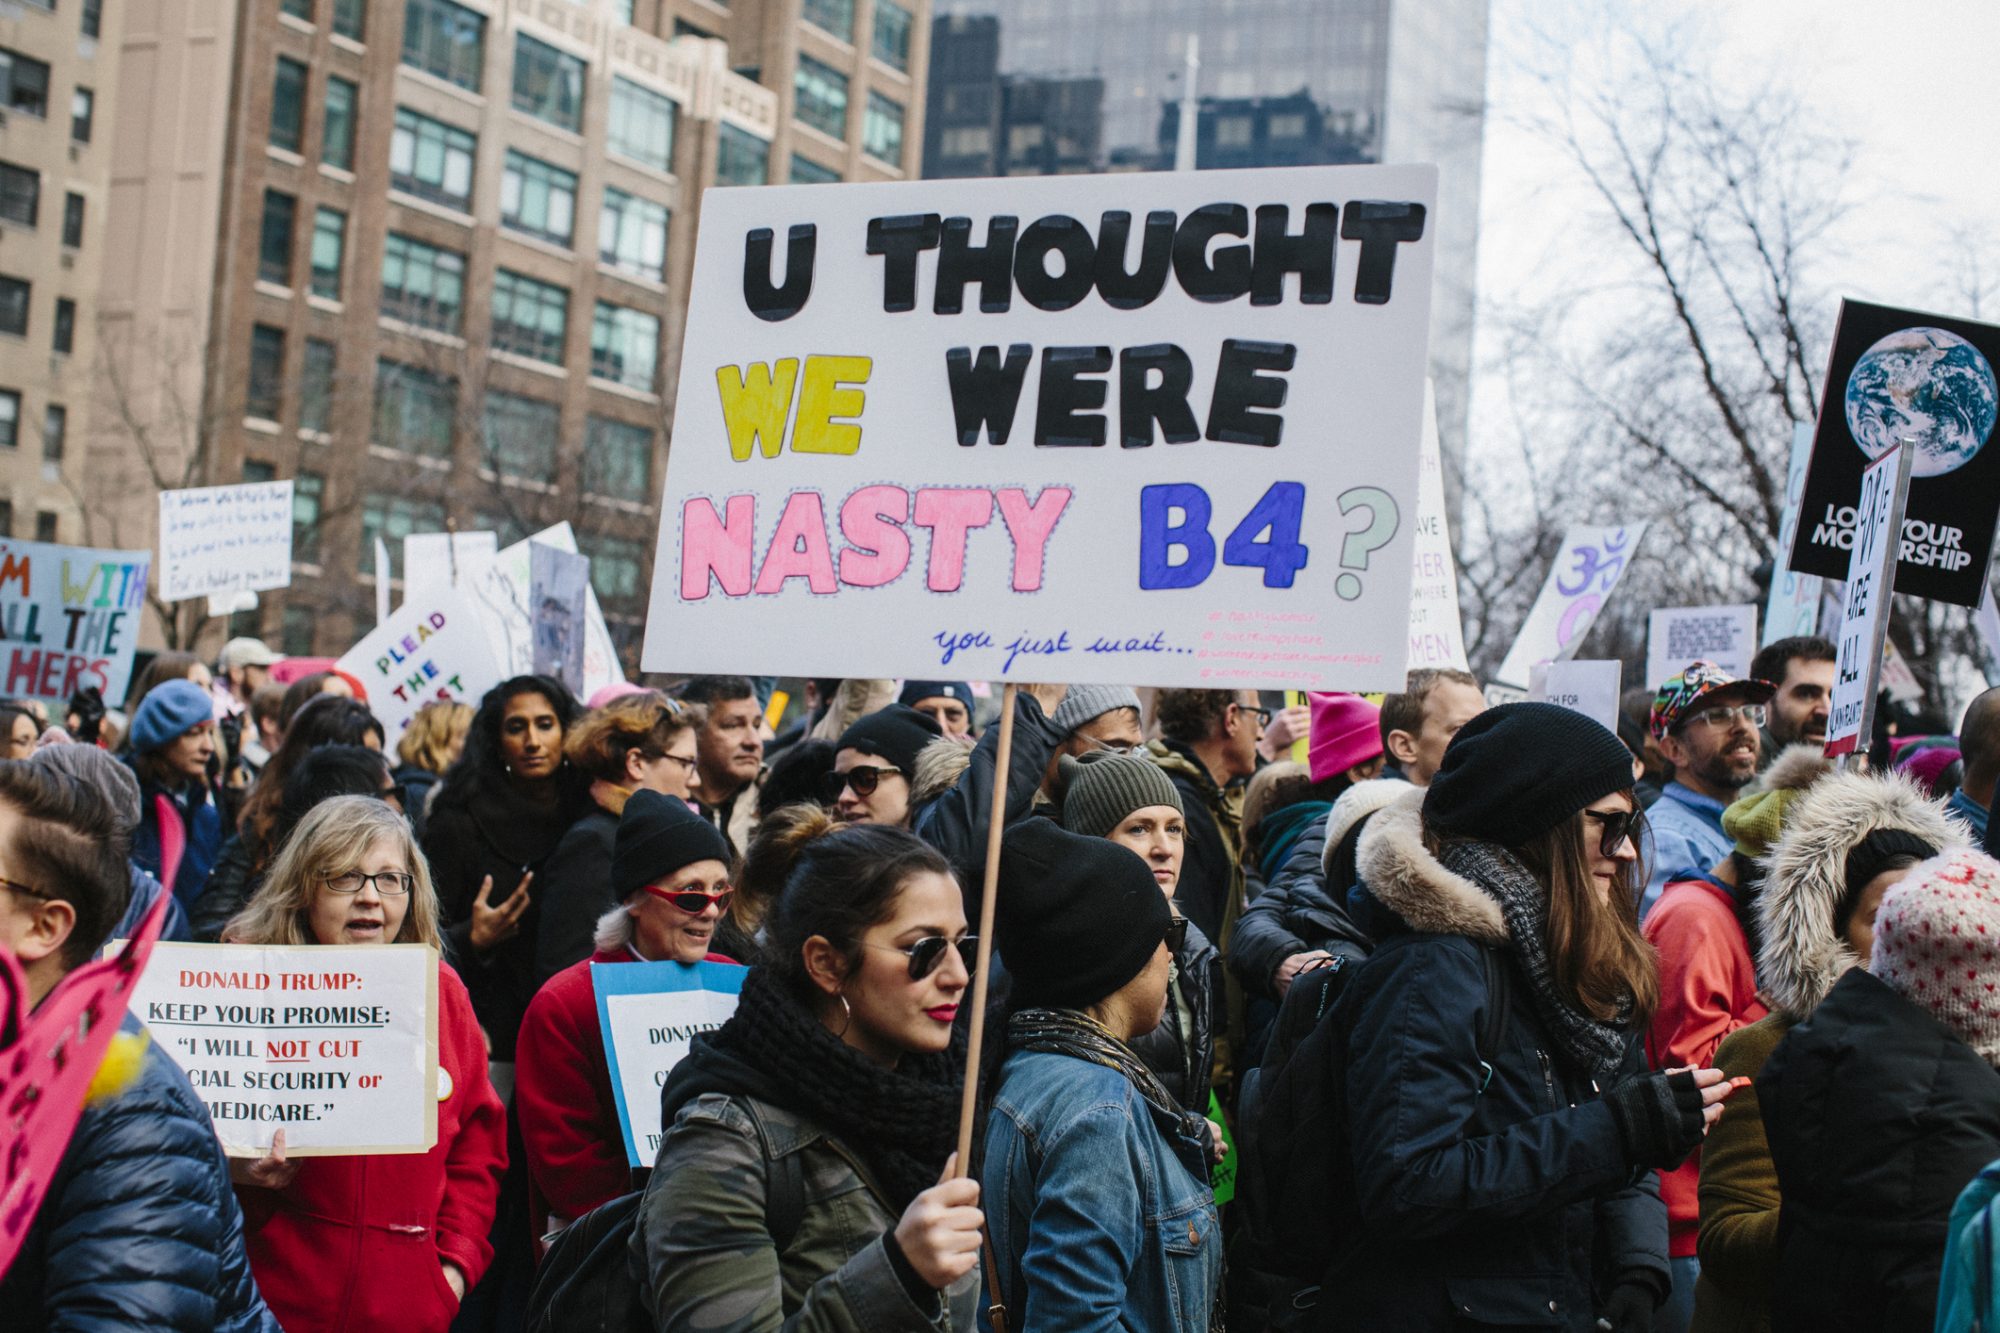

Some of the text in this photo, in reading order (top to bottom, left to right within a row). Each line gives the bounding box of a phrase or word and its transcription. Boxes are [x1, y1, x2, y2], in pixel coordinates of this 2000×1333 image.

[743, 200, 1428, 322] U THOUGHT
[715, 339, 1298, 462] WE WERE
[678, 482, 1075, 602] NASTY
[61, 559, 149, 608] WITH
[1847, 571, 1871, 621] ARE
[0, 602, 127, 656] LL THE
[377, 613, 445, 675] PLEAD
[933, 631, 994, 665] you
[1001, 630, 1073, 675] just
[6, 648, 110, 699] HERS
[393, 660, 439, 702] THE
[1840, 634, 1860, 686] ALL
[180, 970, 362, 990] DONALD TRUMP:
[149, 1002, 390, 1025] KEEP YOUR PROMISE:
[205, 1039, 259, 1057] WILL
[267, 1041, 310, 1058] NOT
[319, 1040, 362, 1058] CUT
[243, 1071, 351, 1090] SECURITY
[358, 1075, 383, 1089] or
